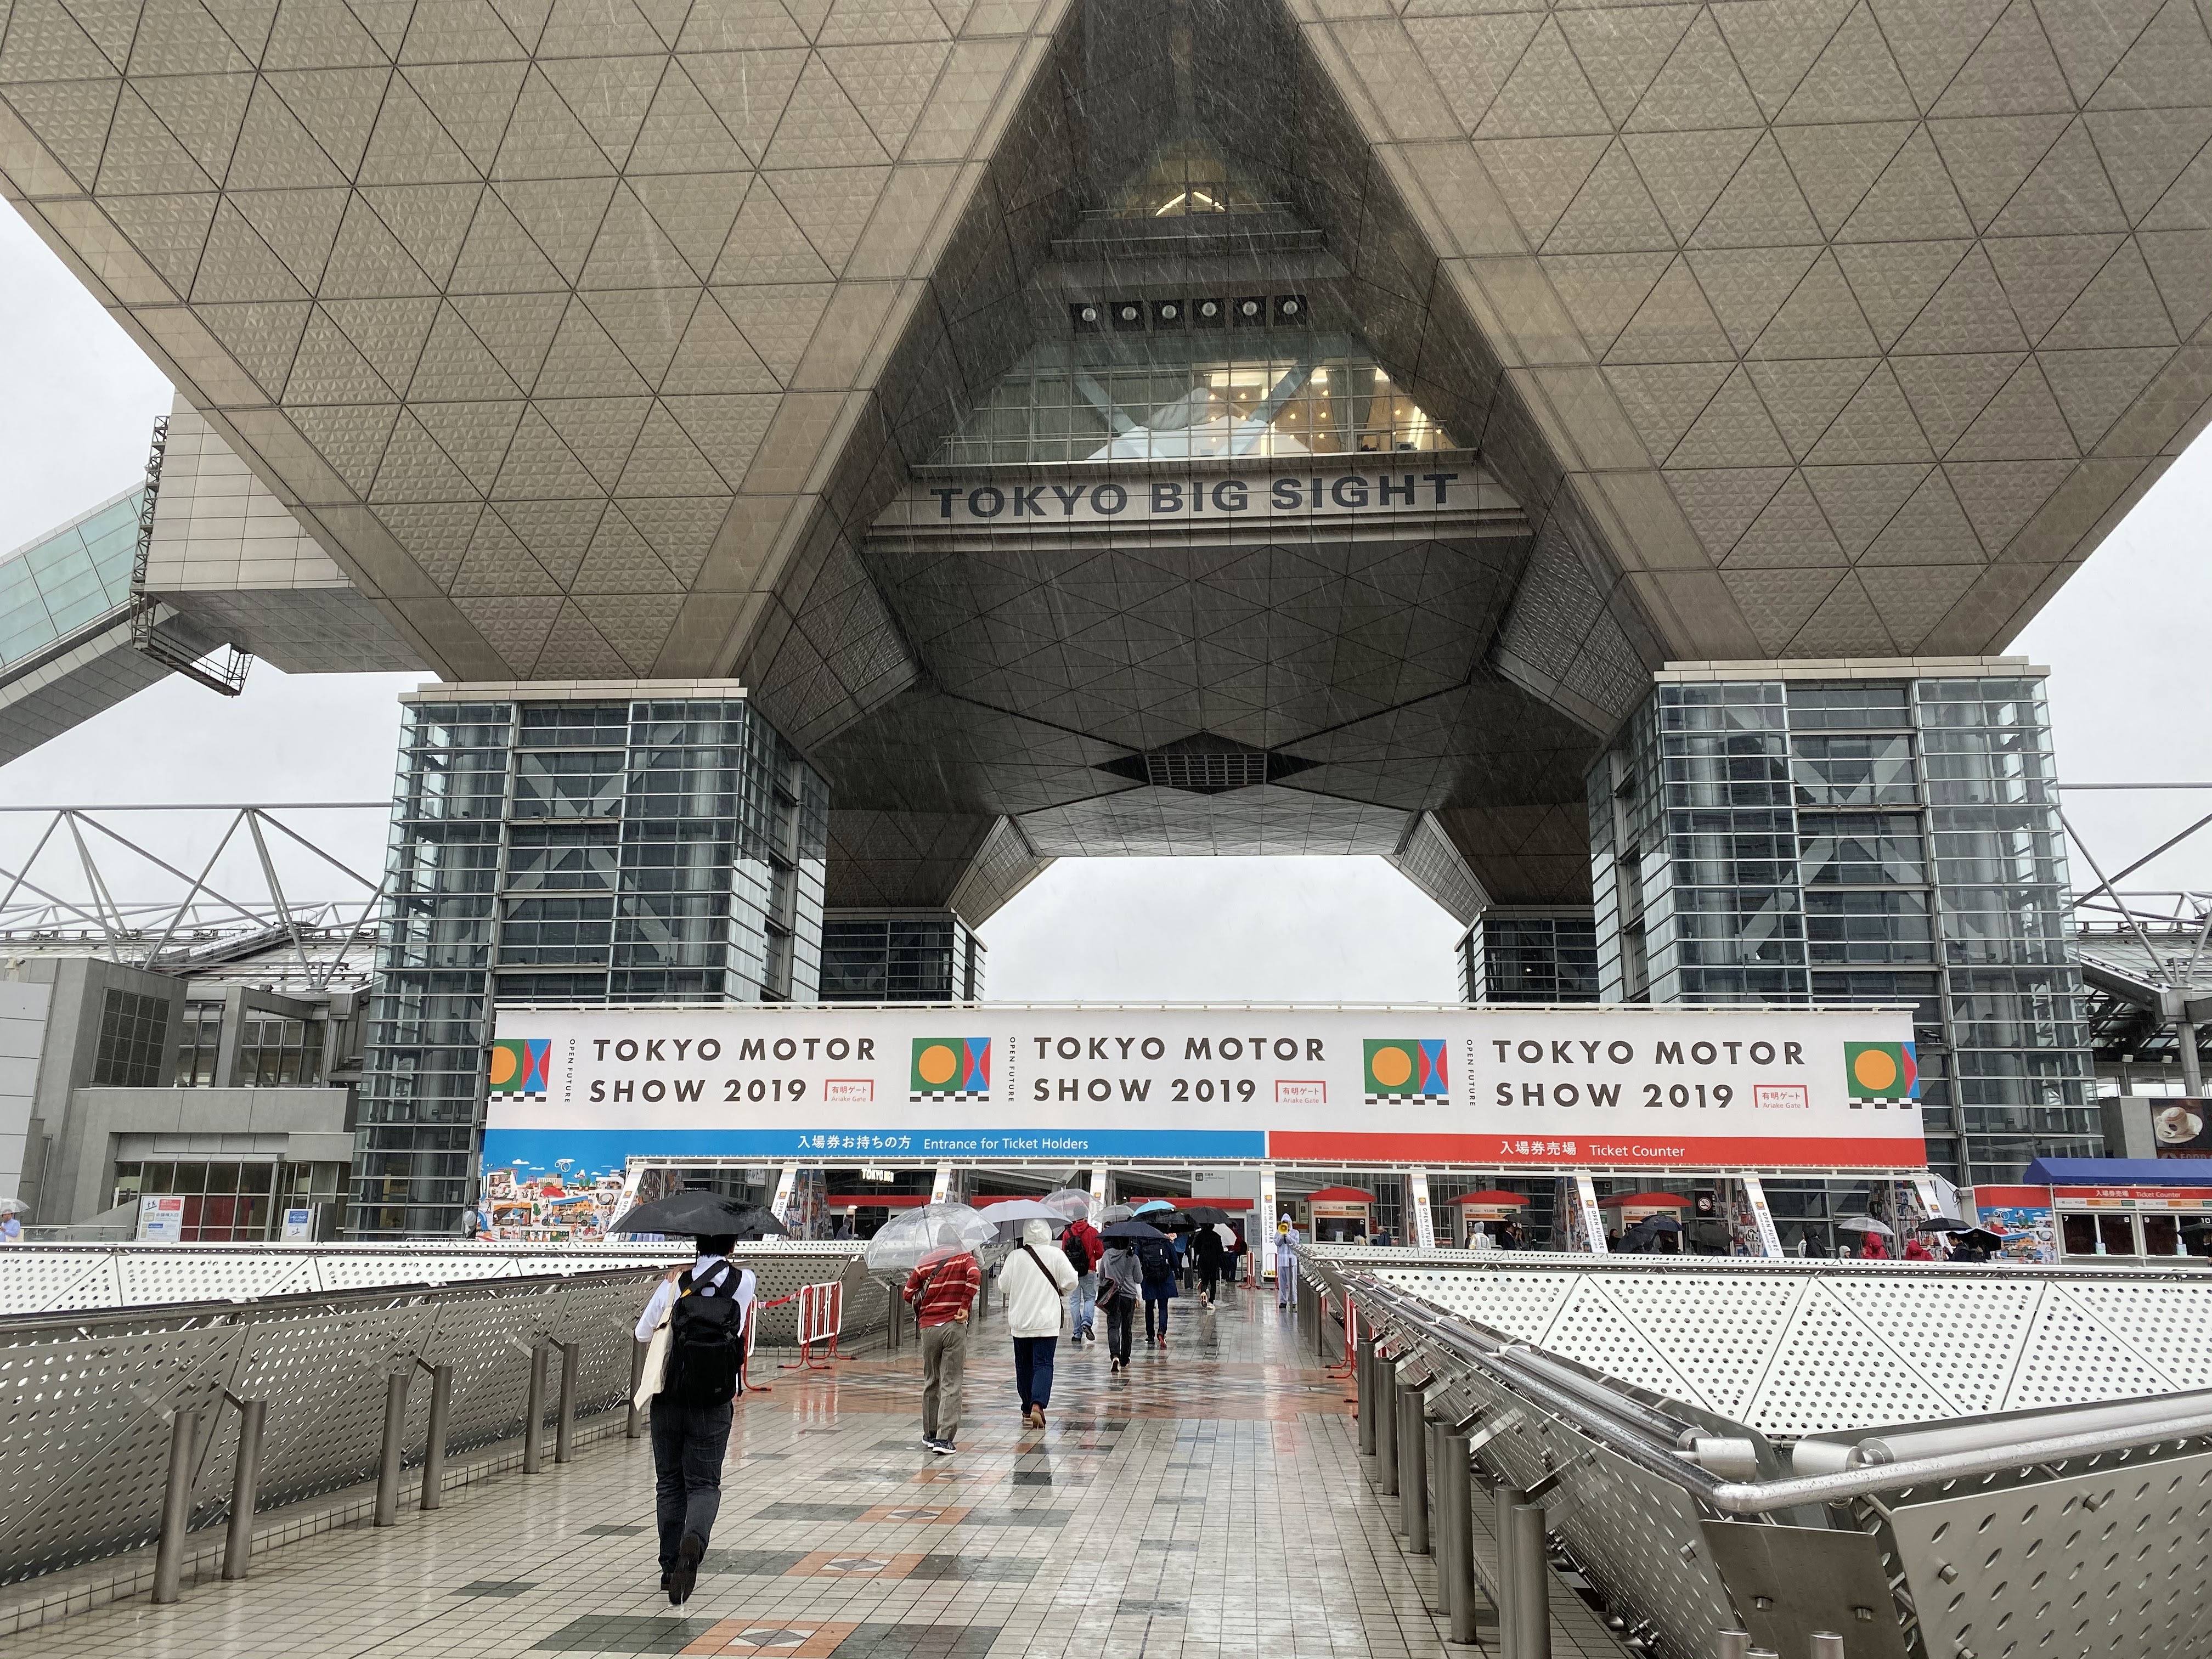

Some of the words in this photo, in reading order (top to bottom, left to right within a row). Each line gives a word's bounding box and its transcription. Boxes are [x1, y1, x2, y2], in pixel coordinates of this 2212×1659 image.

[930, 484, 1127, 518] TOKYO
[1152, 480, 1249, 513] BIG
[1271, 473, 1459, 510] SIGHT
[593, 1039, 721, 1062] TOKYO
[739, 1038, 875, 1060] MOTOR
[1034, 1037, 1165, 1060] TOKYO
[1184, 1037, 1325, 1061] MOTOR
[1492, 1040, 1634, 1064] TOKYO
[1655, 1041, 1805, 1065] MOTOR
[565, 1068, 573, 1103] FUTURE
[589, 1080, 706, 1103] SHOW
[723, 1079, 806, 1102] 2019
[832, 1086, 867, 1094] 有明ゲート
[1033, 1078, 1152, 1102] SHOW
[1171, 1079, 1256, 1102] 2019
[1283, 1087, 1319, 1096] 有明ゲート
[1496, 1082, 1622, 1107] SHOW
[1643, 1084, 1733, 1108] 2019
[1762, 1092, 1801, 1100] 有明ゲート
[797, 1135, 912, 1149] 入場券お持ちの方
[924, 1138, 977, 1149] Entrance
[980, 1137, 999, 1149] for
[1002, 1137, 1038, 1149] Ticket
[1042, 1137, 1088, 1149] Holders
[1500, 1141, 1577, 1156] 入場券売場
[1589, 1144, 1629, 1156] Ticket
[1632, 1145, 1685, 1157] Counter
[1596, 1227, 1604, 1249] FUTURE
[1768, 1229, 1779, 1251] FUTURE
